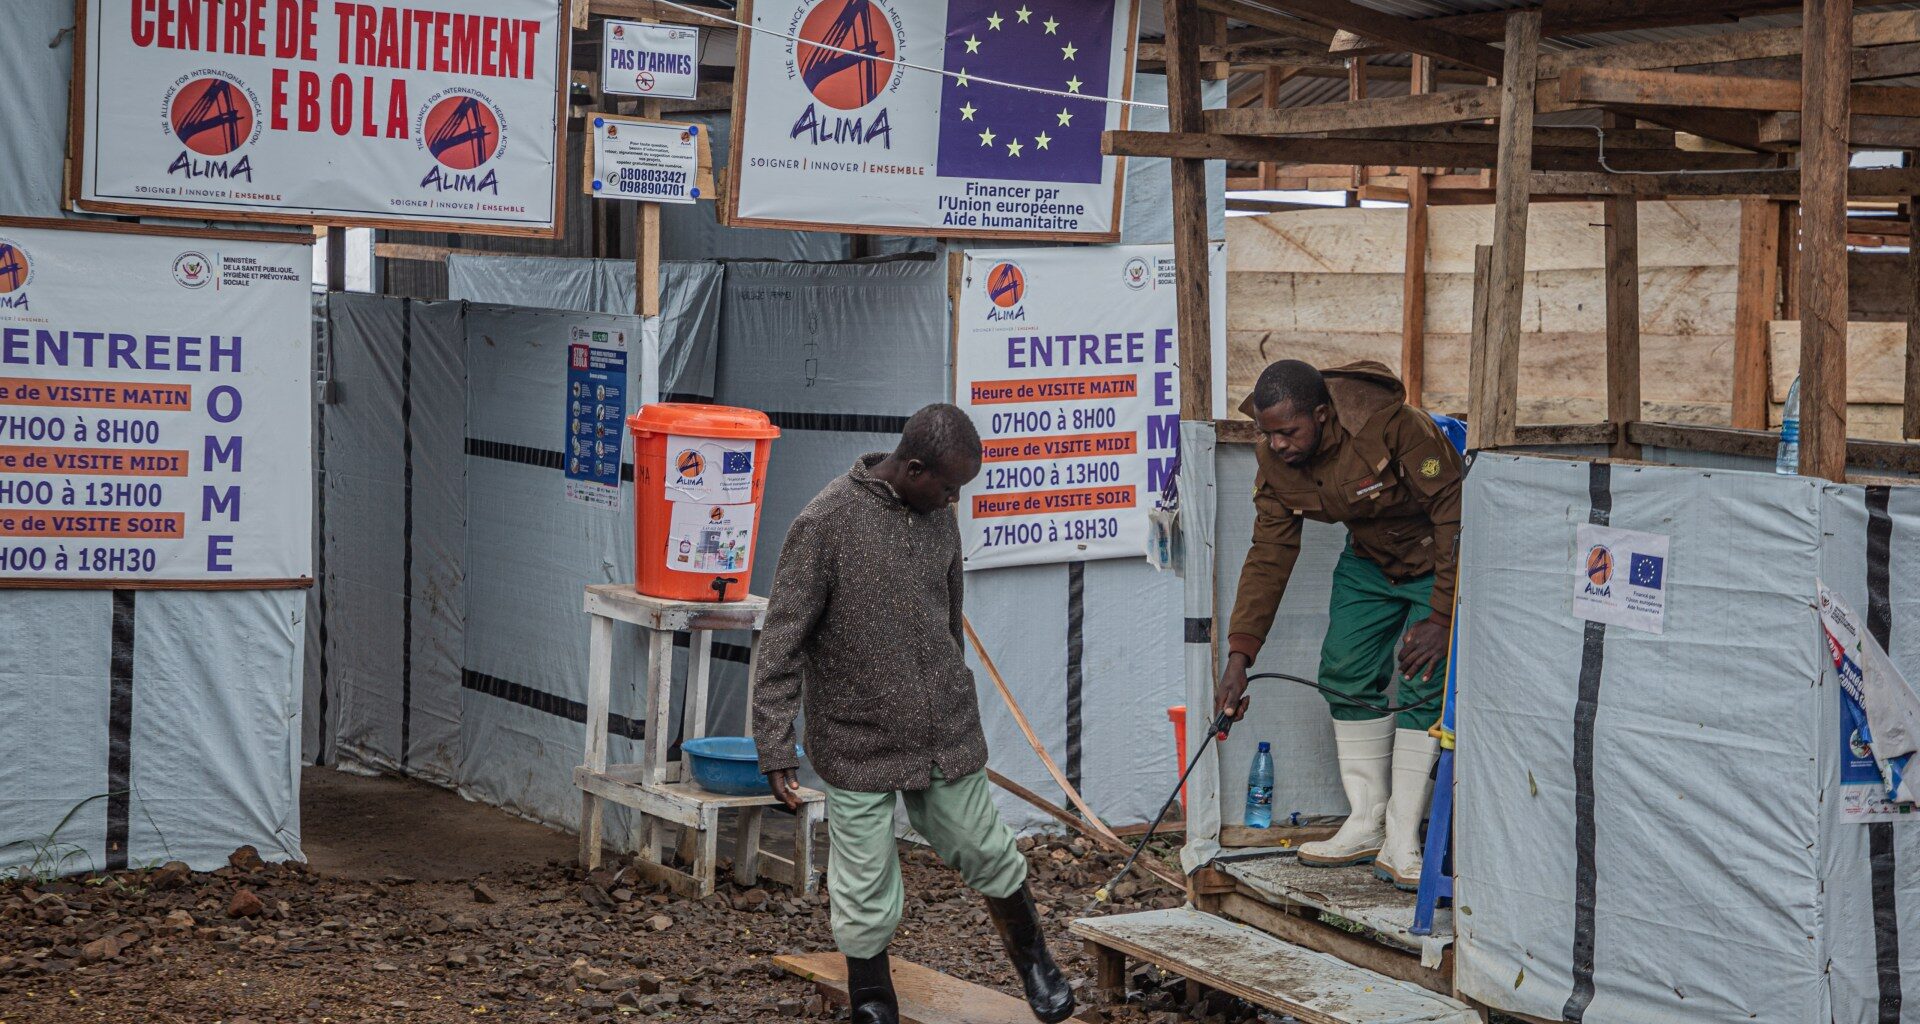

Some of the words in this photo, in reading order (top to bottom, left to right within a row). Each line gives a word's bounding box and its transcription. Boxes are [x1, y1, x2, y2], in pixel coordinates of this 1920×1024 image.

[131, 0, 266, 56] CENTRE
[276, 0, 318, 61] DE
[334, 2, 540, 80] TRAITEMENT
[786, 60, 796, 80] THE
[888, 8, 906, 51] MEDICAL
[611, 48, 634, 70] PAS
[638, 51, 692, 75] D'ARMES
[175, 74, 189, 86] FOR
[160, 86, 176, 118] ALLIANCE
[246, 88, 262, 117] MEDICAL
[271, 68, 409, 139] EBOLA
[428, 92, 441, 104] FOR
[160, 121, 170, 136] THE
[415, 104, 429, 134] ALLIANCE
[493, 104, 508, 132] MEDICAL
[790, 102, 892, 150] ALIMA
[250, 120, 262, 146] ACTION
[496, 135, 508, 160] ACTION
[167, 150, 253, 183] ALIMA
[620, 168, 686, 184] 0808033421
[750, 158, 800, 168] SOIGNER
[810, 162, 858, 172] INNOVER
[870, 164, 924, 176] ENSEMBLE
[420, 164, 498, 196] ALIMA
[620, 180, 684, 196] 0988904701
[136, 186, 176, 194] SOIGNER
[186, 189, 226, 198] INNOVER
[236, 192, 282, 200] ENSEMBLE
[966, 182, 1030, 198] Financer
[1035, 188, 1060, 202] par
[390, 199, 428, 207] SOIGNER
[482, 204, 525, 212] ENSEMBLE
[938, 196, 992, 212] l'Union
[996, 198, 1084, 216] européenne
[943, 212, 976, 226] Aide
[982, 214, 1078, 230] humanitaitre
[986, 306, 1025, 322] ALIMA
[3, 328, 202, 372] ENTREE
[1008, 332, 1144, 368] ENTREE
[15, 384, 40, 400] de
[46, 386, 116, 402] VISITE
[123, 388, 188, 405] MATIN
[971, 386, 1012, 400] Heure
[1017, 385, 1034, 398] de
[1038, 382, 1085, 396] VISITE
[1090, 380, 1135, 394] MATIN
[74, 416, 87, 442] à
[1057, 408, 1066, 430] à
[1147, 328, 1180, 508] FEMM
[982, 442, 1020, 458] Heure
[1024, 443, 1040, 456] de
[1044, 440, 1091, 454] VISITE
[1096, 438, 1130, 451] MIDI
[23, 453, 48, 468] de
[53, 454, 123, 470] VISITE
[130, 456, 179, 471] MIDI
[676, 476, 704, 486] ALIMA
[1050, 463, 1060, 486] à
[62, 479, 75, 506] à
[978, 500, 1020, 513] Heure
[1024, 497, 1040, 510] de
[1044, 494, 1092, 508] VISITE
[1096, 491, 1130, 504] SOIR
[22, 516, 46, 531] de
[52, 516, 121, 532] VISITE
[126, 518, 176, 532] SOIR
[1050, 520, 1058, 542] à
[1064, 517, 1118, 540] 18H30
[54, 545, 68, 571] à
[78, 548, 156, 572] 18H30
[1585, 582, 1611, 598] ALIMA
